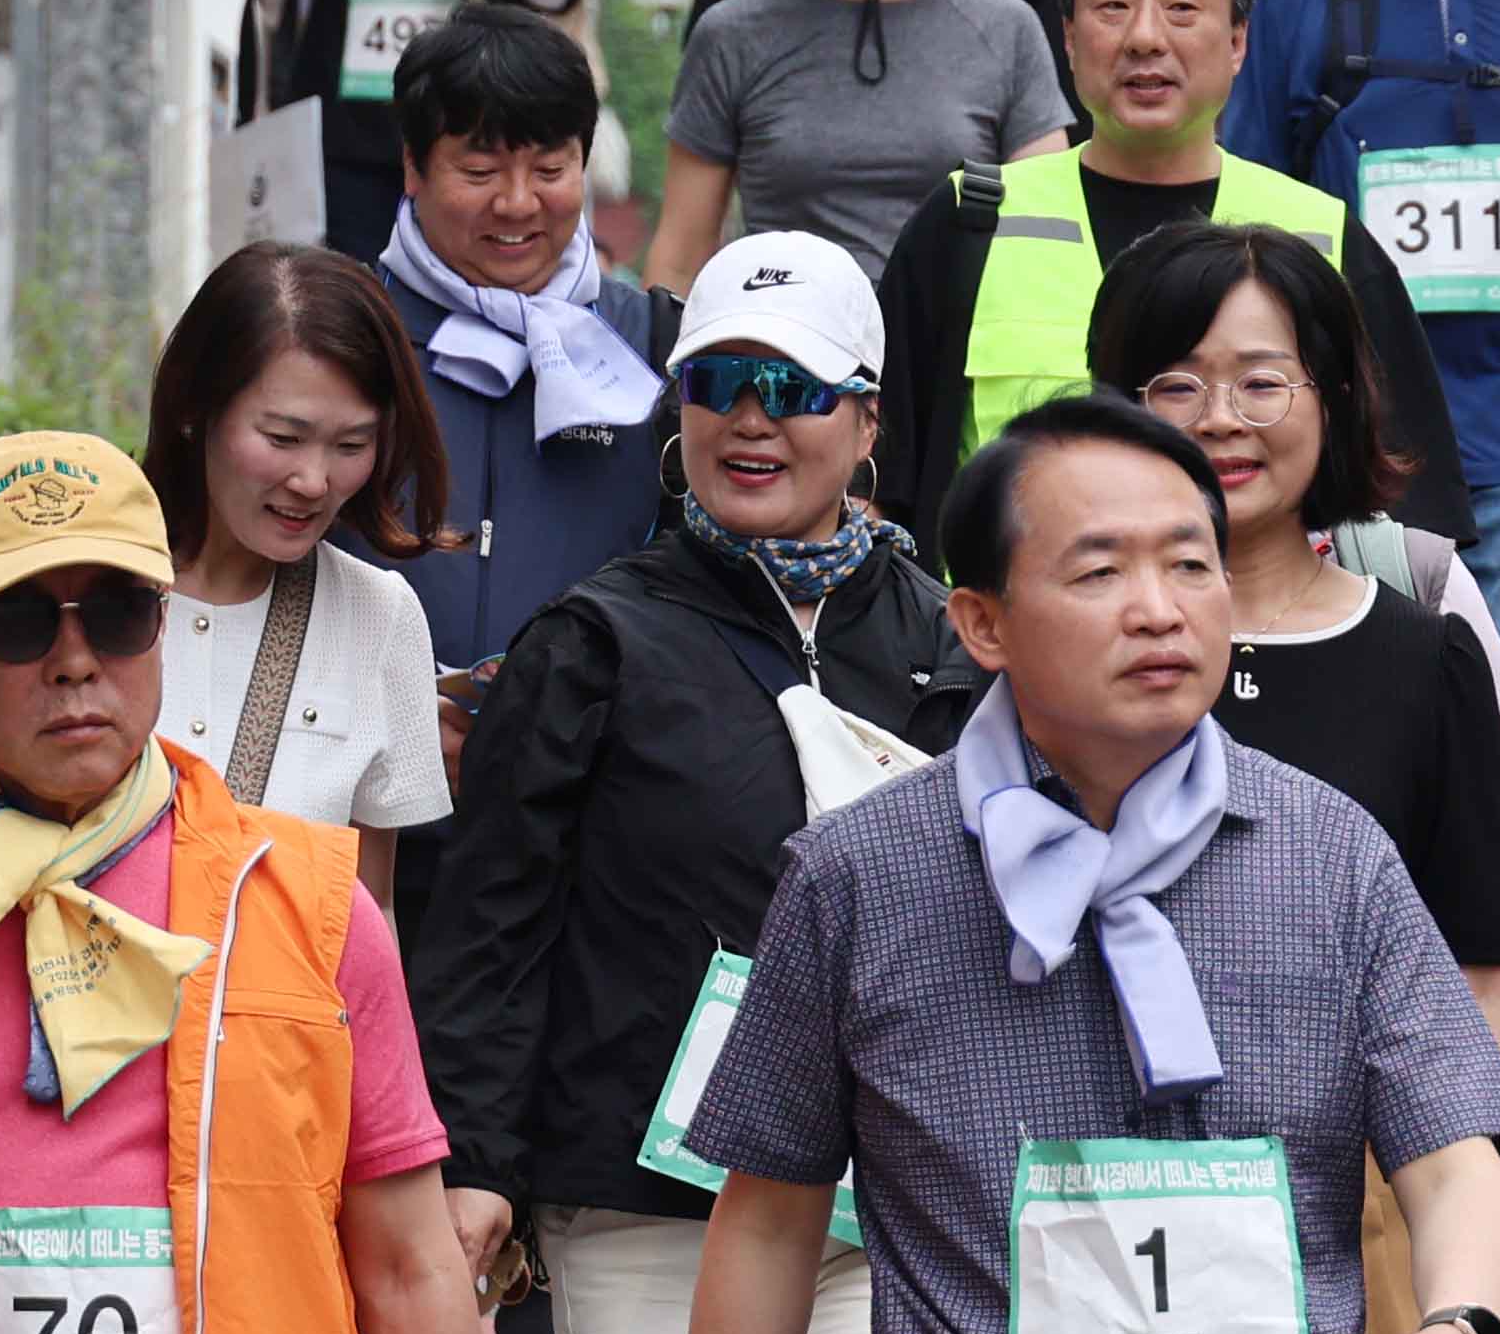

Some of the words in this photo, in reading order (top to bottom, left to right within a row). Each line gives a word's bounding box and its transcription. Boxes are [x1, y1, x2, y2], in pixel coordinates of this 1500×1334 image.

[754, 267, 793, 284] NIKE
[1025, 1163, 1062, 1194] 제1회
[1063, 1160, 1162, 1194] 현대시장에서
[1165, 1158, 1213, 1189] 떠나는
[1215, 1155, 1277, 1192] 동구여행
[90, 1228, 141, 1259] 떠나는
[1134, 1227, 1169, 1313] 1
